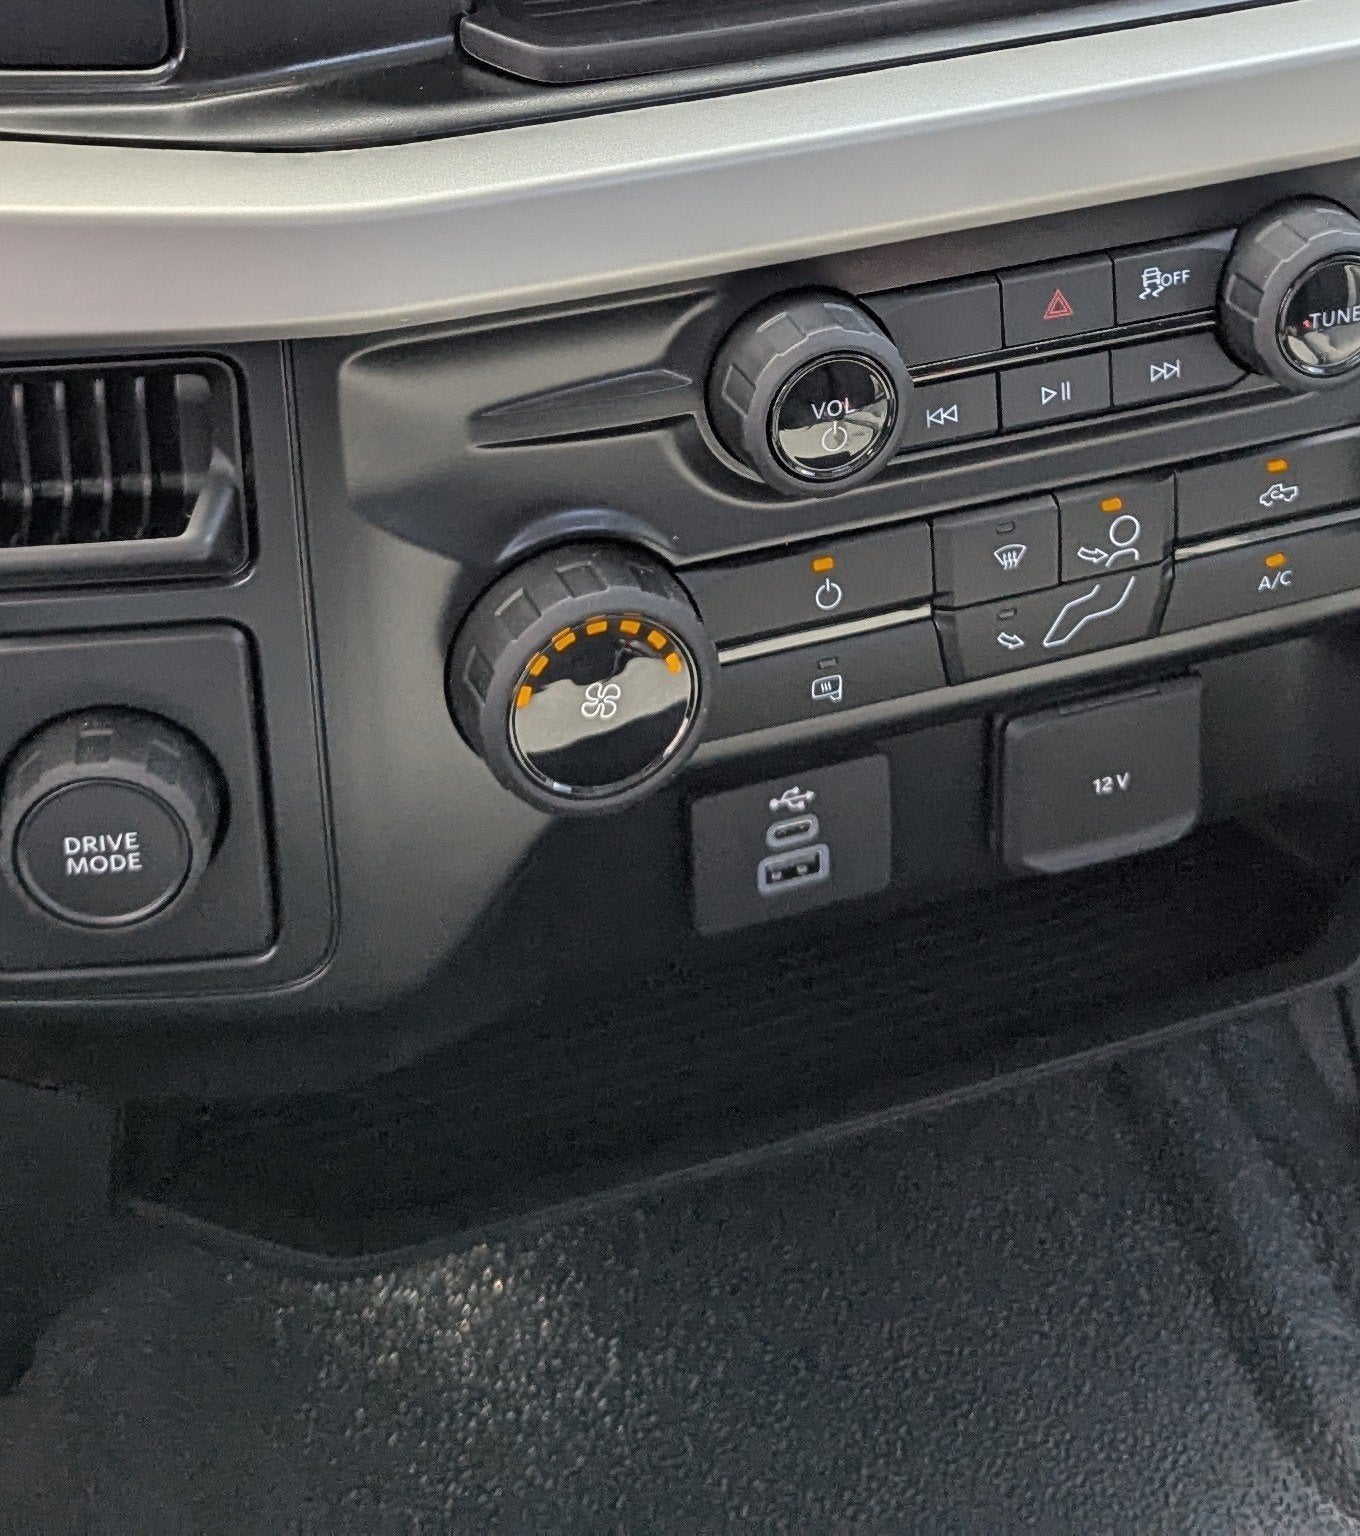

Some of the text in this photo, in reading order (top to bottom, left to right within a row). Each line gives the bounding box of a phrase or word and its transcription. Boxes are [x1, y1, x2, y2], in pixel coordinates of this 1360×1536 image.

[1160, 269, 1191, 287] OFF
[810, 397, 858, 420] VOL
[1257, 569, 1293, 592] A/C
[63, 831, 140, 856] DRIVE
[66, 851, 143, 876] MODE
